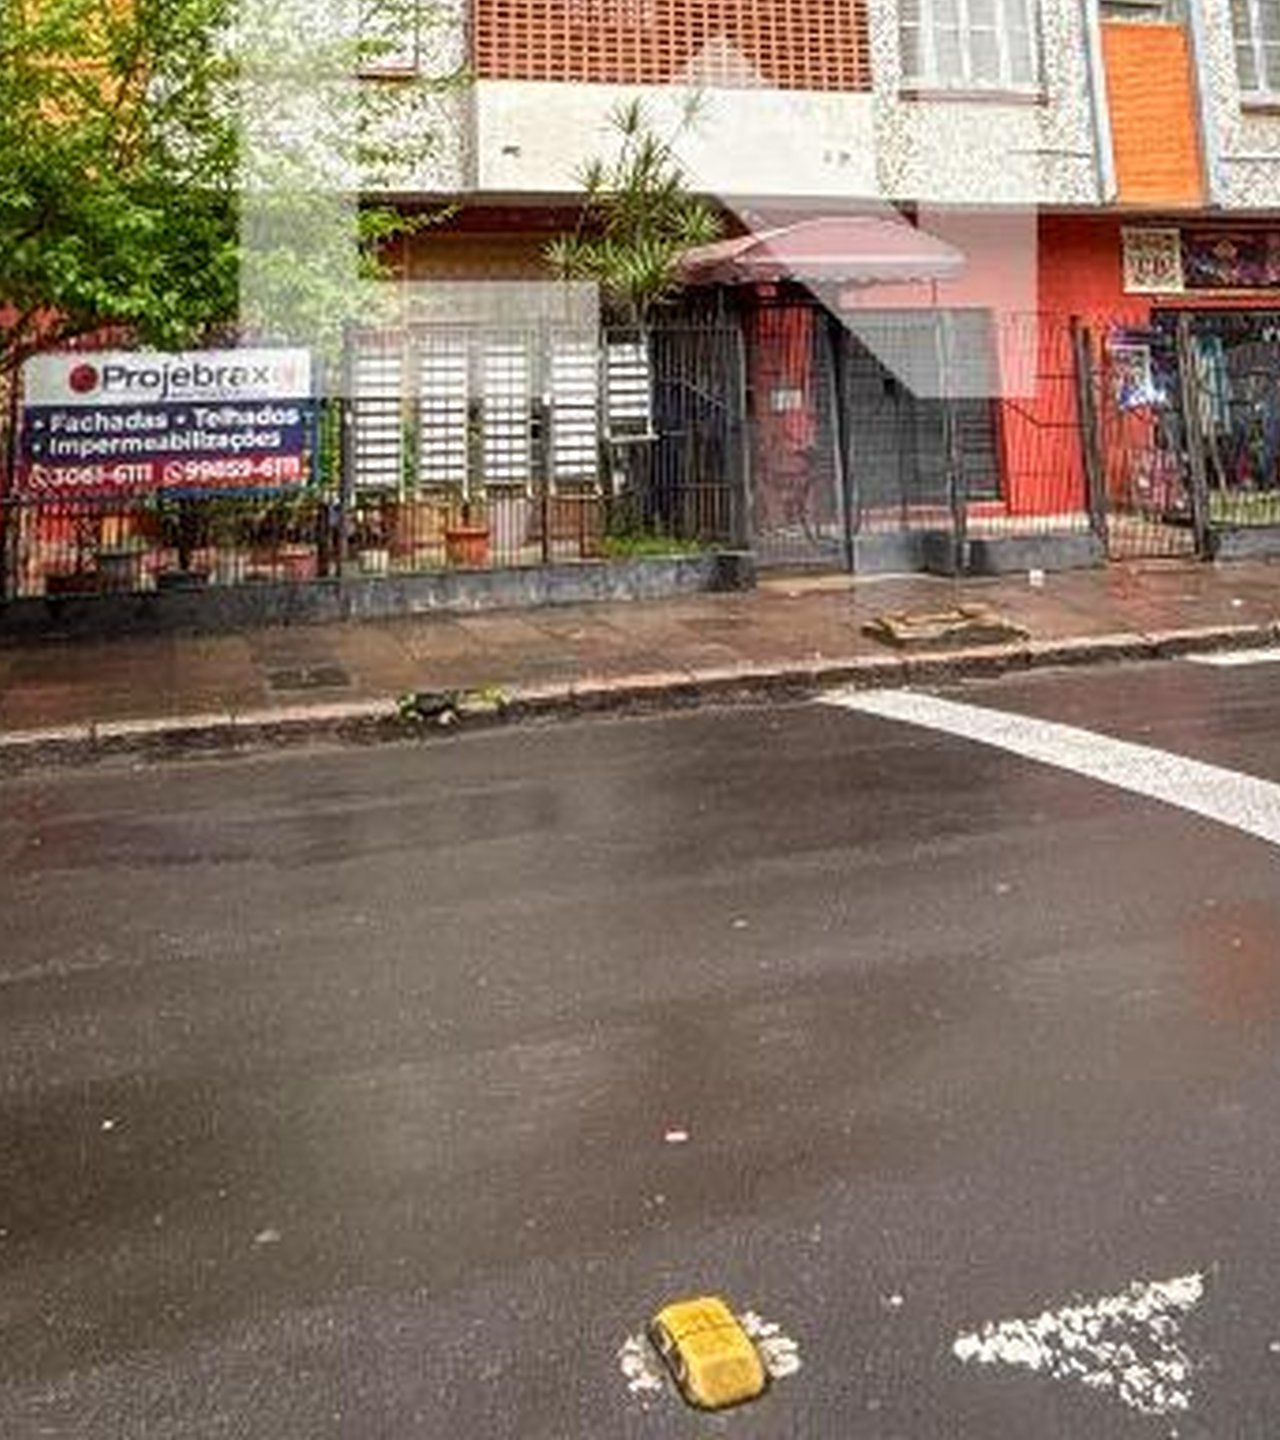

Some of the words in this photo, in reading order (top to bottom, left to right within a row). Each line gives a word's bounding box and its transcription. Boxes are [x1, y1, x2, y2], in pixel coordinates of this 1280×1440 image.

[102, 362, 270, 398] Projebrax
[51, 410, 167, 433] Fachadas
[194, 405, 299, 429] Telhados
[51, 429, 281, 458] Impermeabilizações
